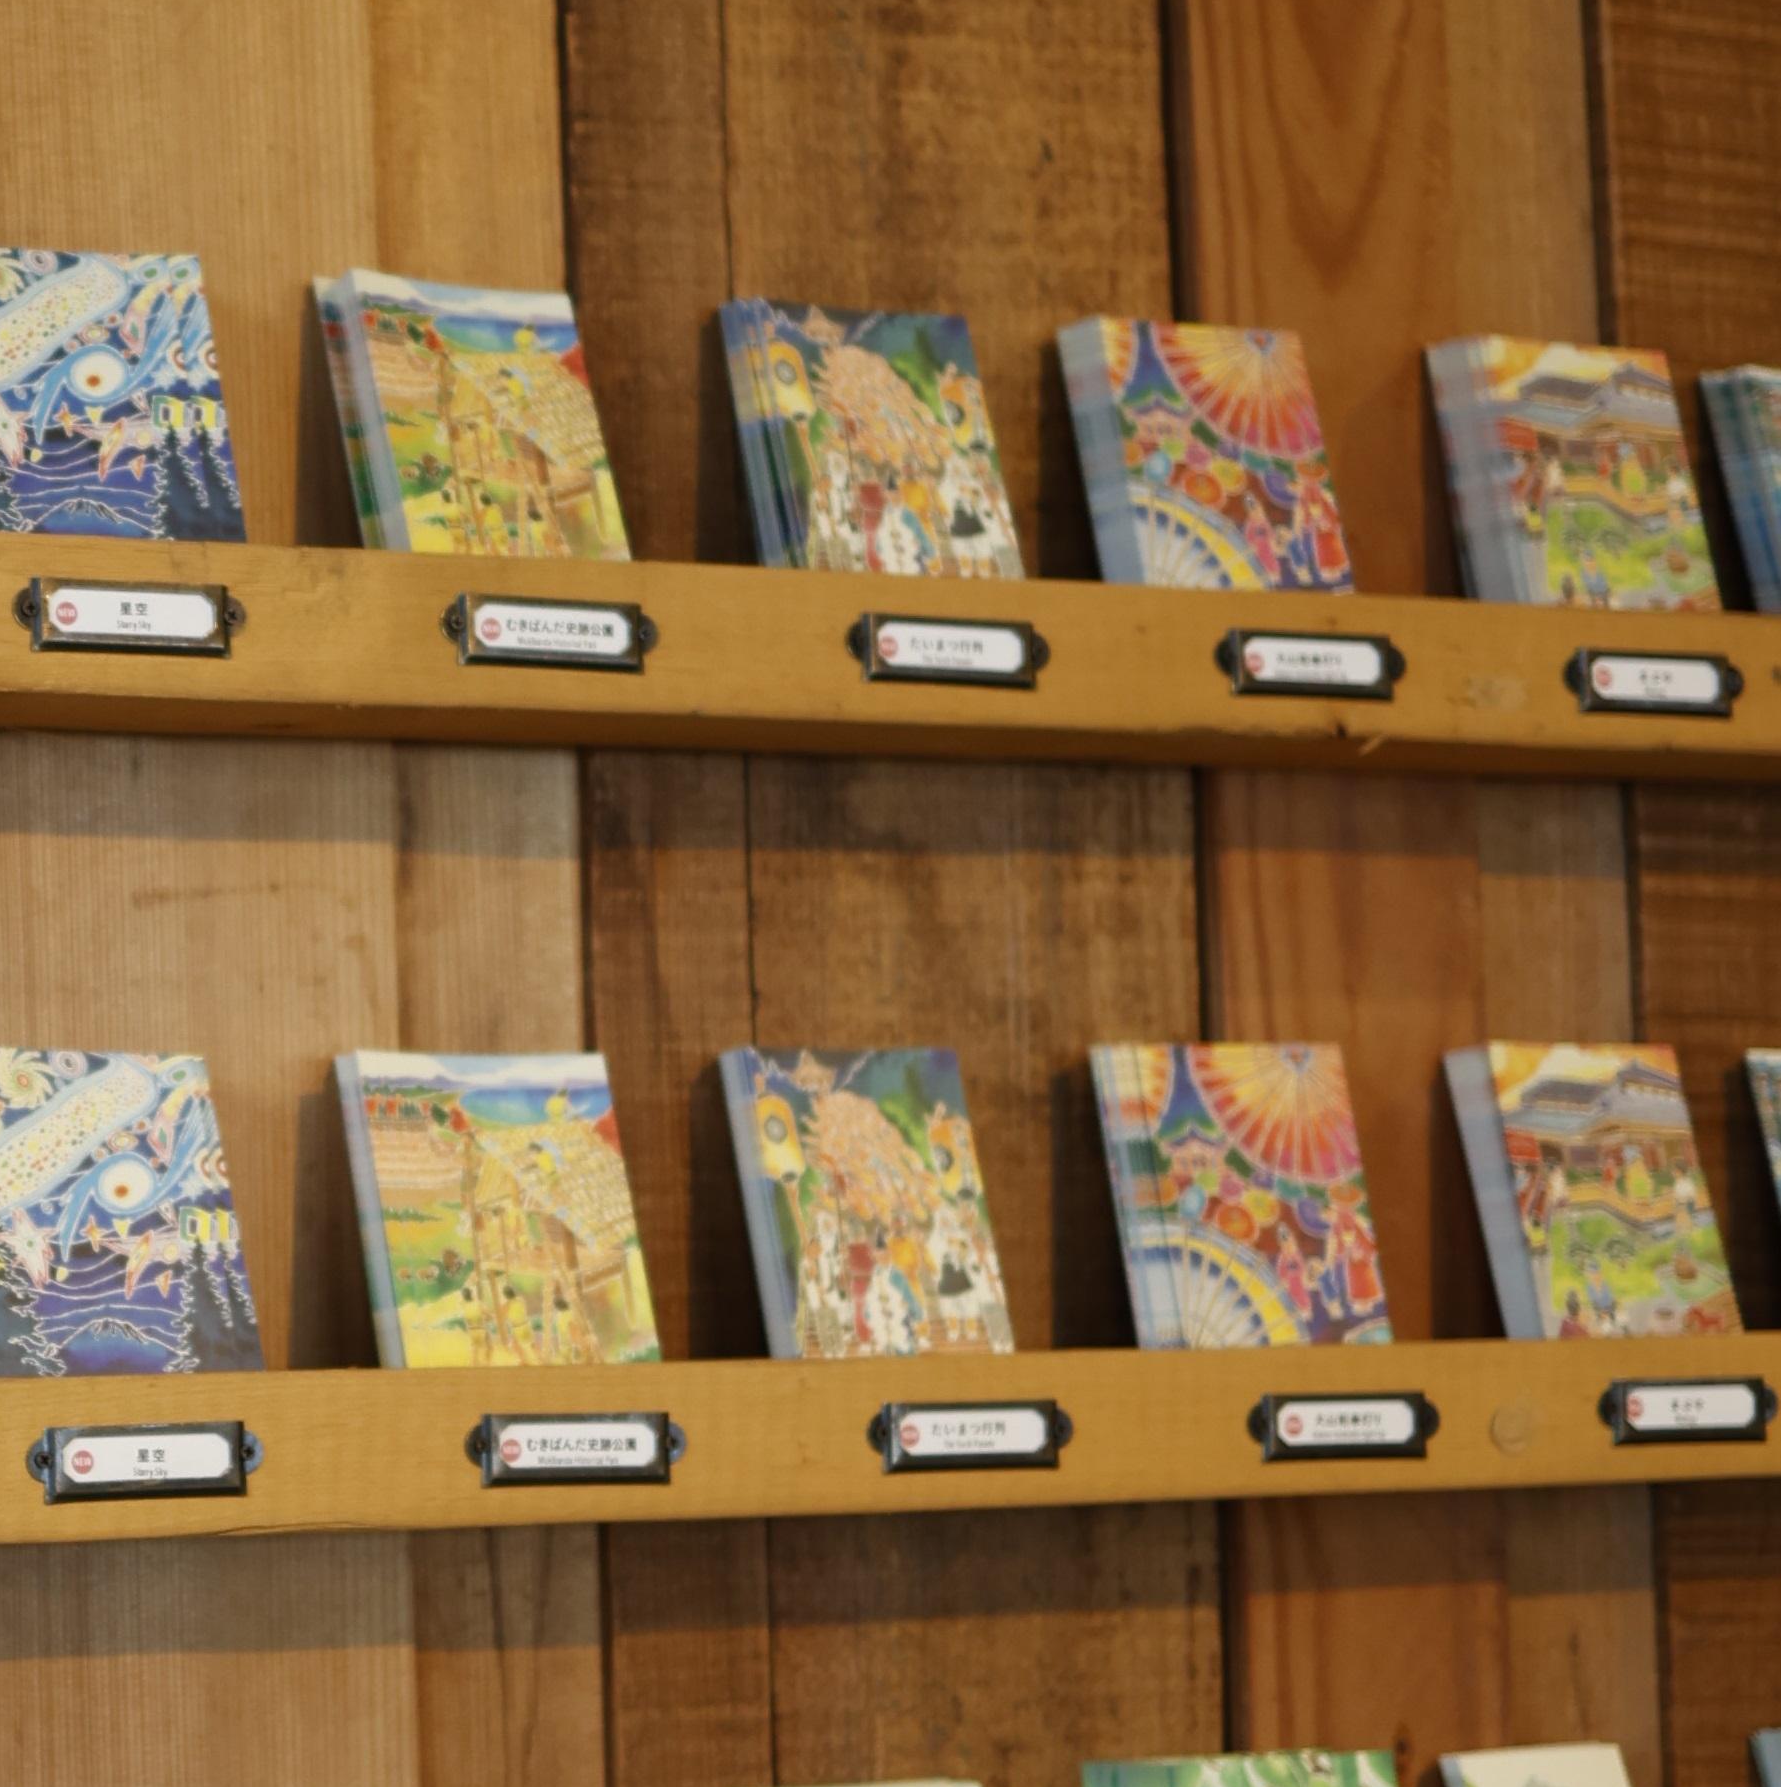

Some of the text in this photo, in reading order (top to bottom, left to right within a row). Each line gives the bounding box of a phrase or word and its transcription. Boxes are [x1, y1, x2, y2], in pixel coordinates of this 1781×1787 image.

[120, 601, 148, 616] 星空
[526, 1437, 638, 1453] むきばんだ史跡公園
[73, 1456, 93, 1468] NEW
[136, 1448, 166, 1464] 星空
